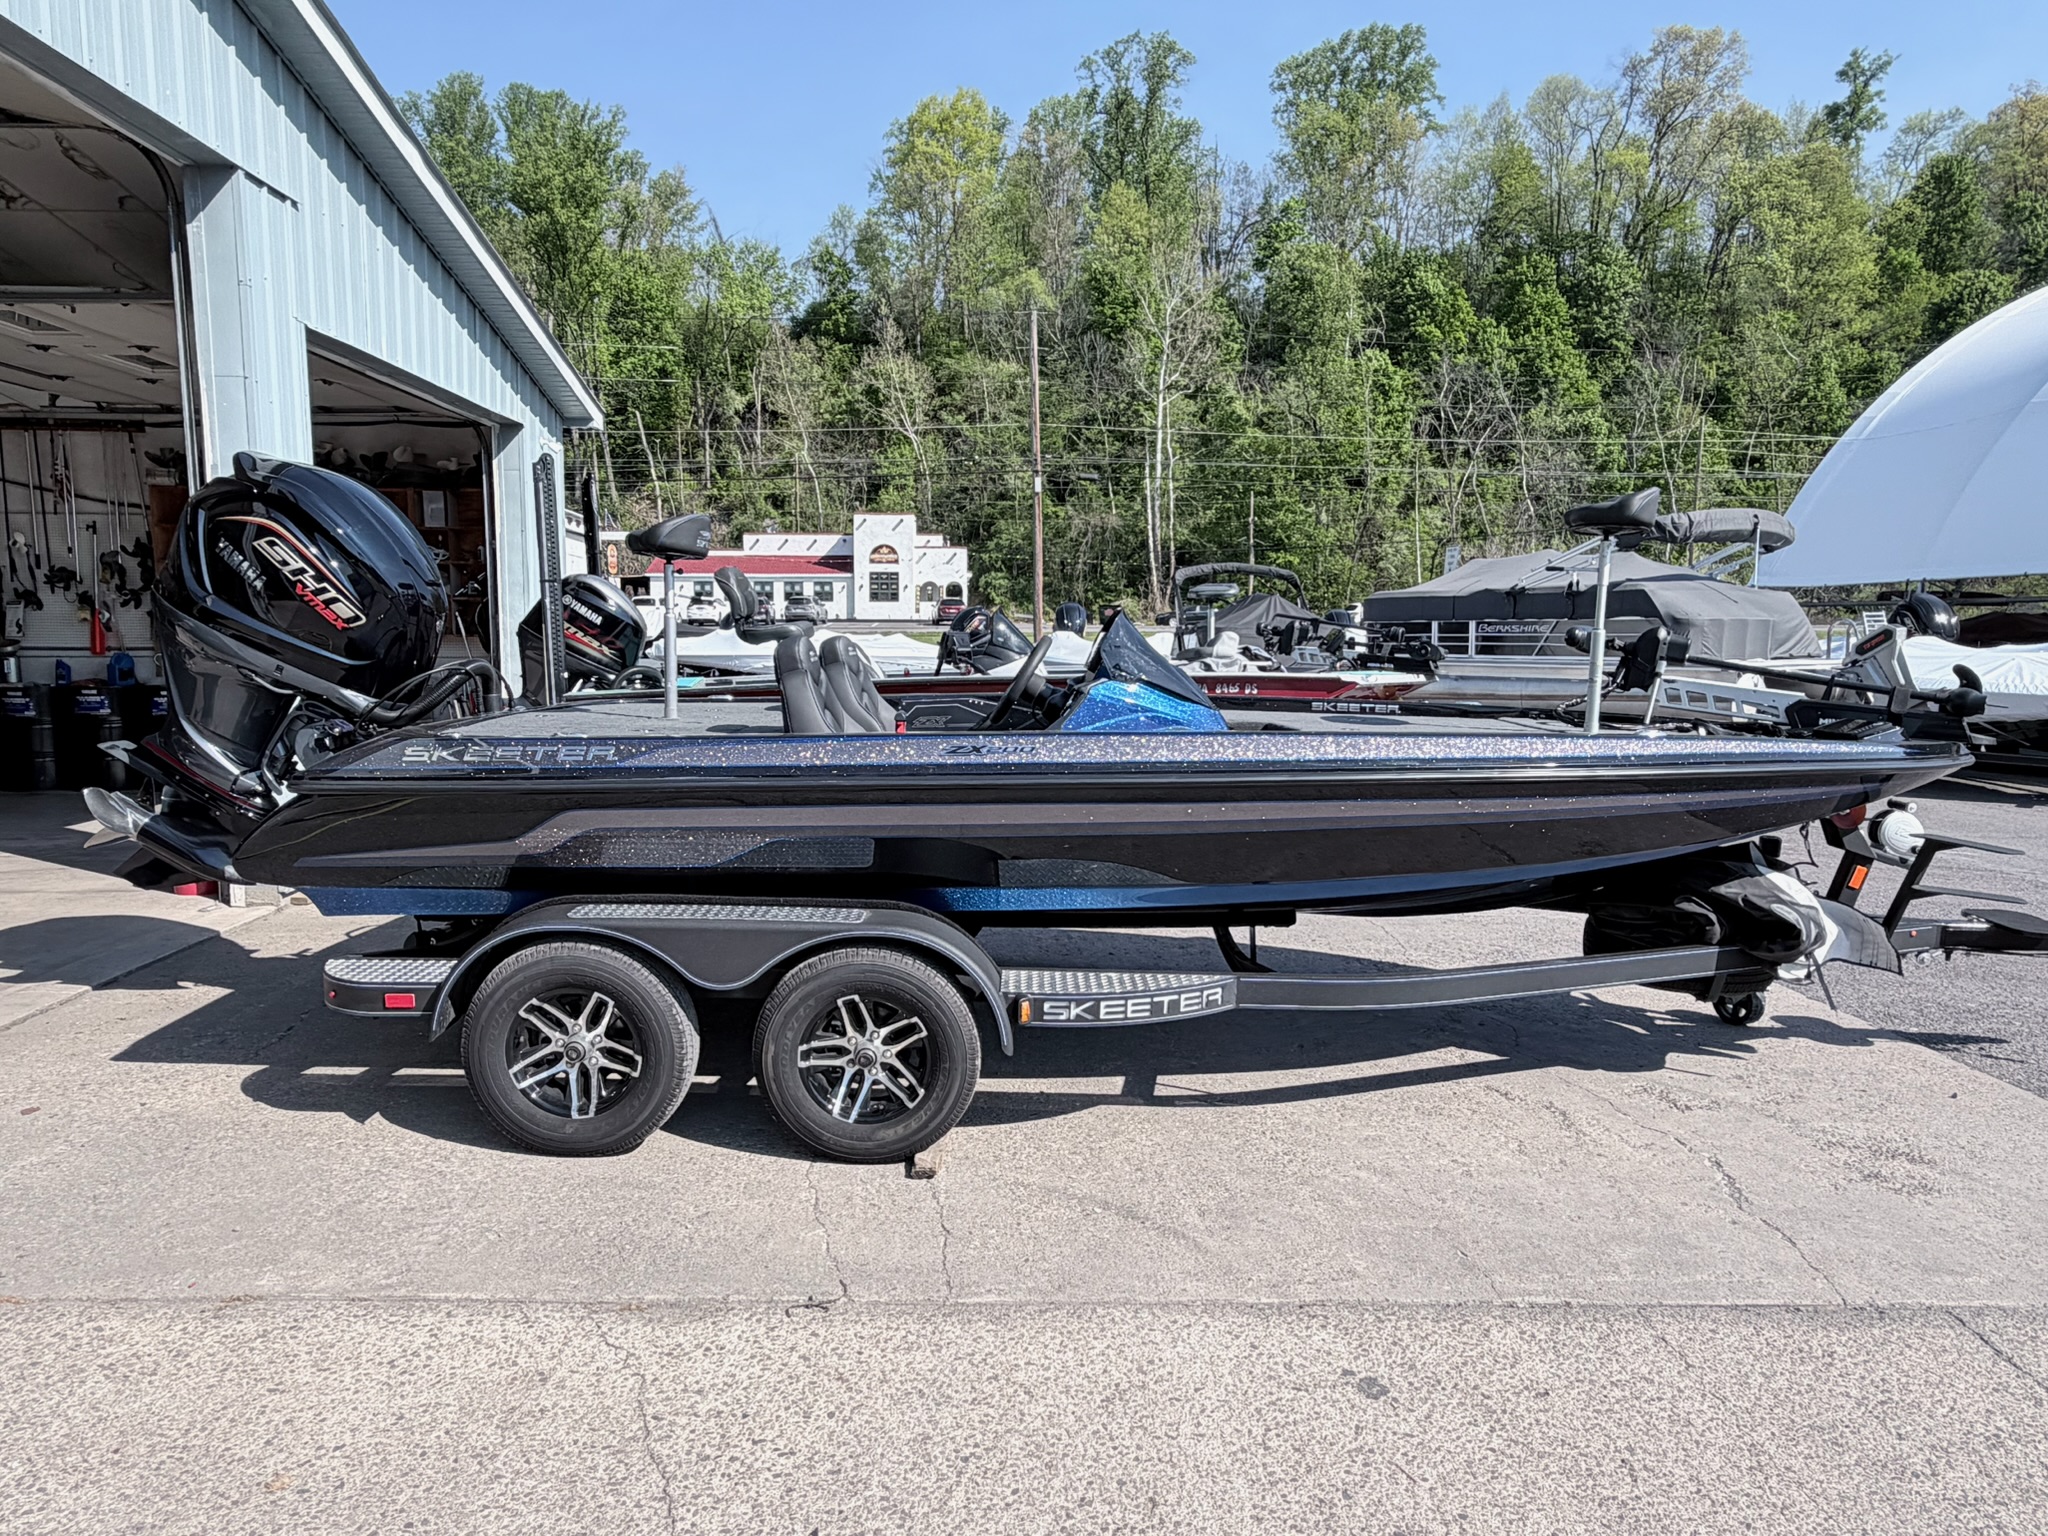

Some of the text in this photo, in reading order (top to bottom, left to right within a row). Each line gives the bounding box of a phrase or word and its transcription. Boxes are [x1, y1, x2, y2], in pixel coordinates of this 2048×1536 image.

[215, 537, 268, 591] YAMAHA
[252, 536, 367, 628] SHO
[570, 599, 603, 626] YAMAHA
[1478, 623, 1550, 633] BERKSHIRE
[1244, 683, 1259, 695] DS
[1311, 701, 1401, 714] SKEETER
[401, 745, 617, 762] SKEETER
[1043, 987, 1223, 1021] SKEETER
